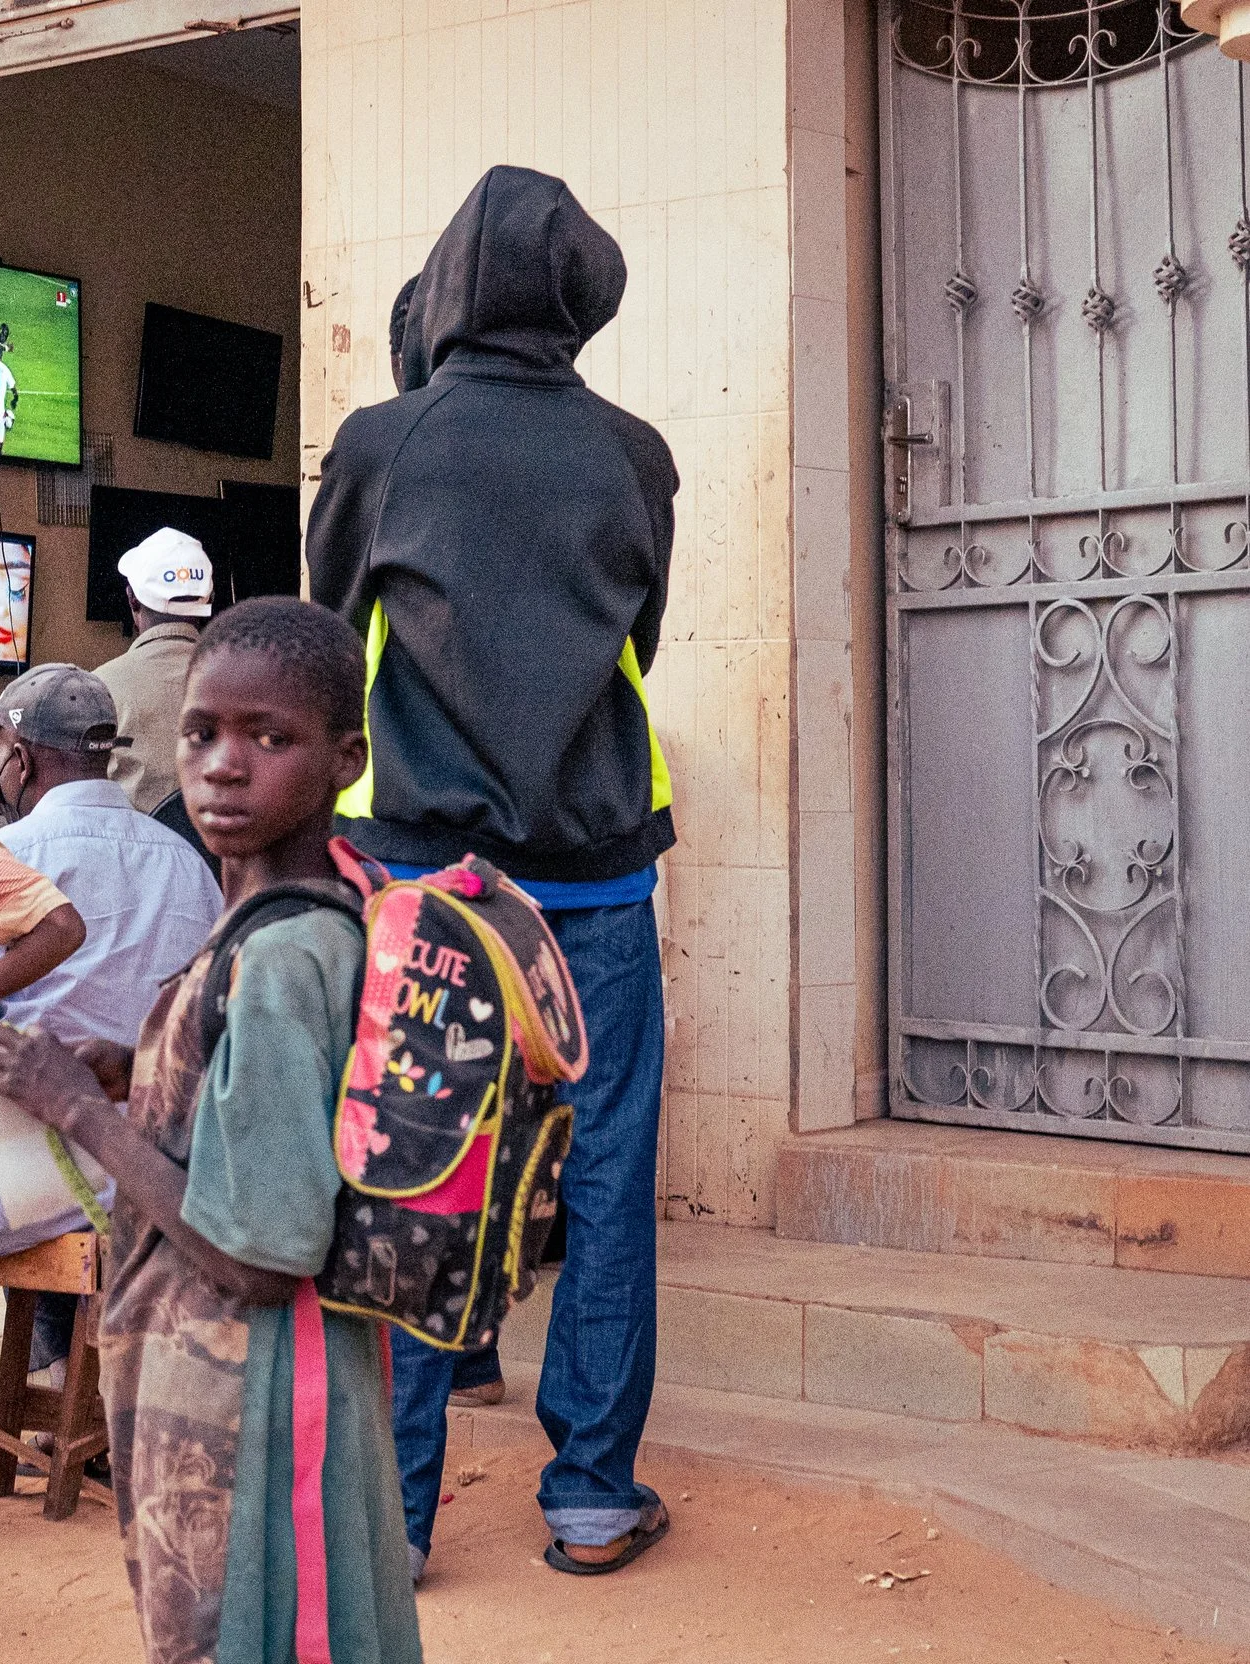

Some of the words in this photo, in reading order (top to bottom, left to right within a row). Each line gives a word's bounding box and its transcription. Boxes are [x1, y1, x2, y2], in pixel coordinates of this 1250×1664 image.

[163, 566, 204, 584] OOLU
[408, 937, 472, 987] CUTE
[394, 977, 451, 1030] OWL
